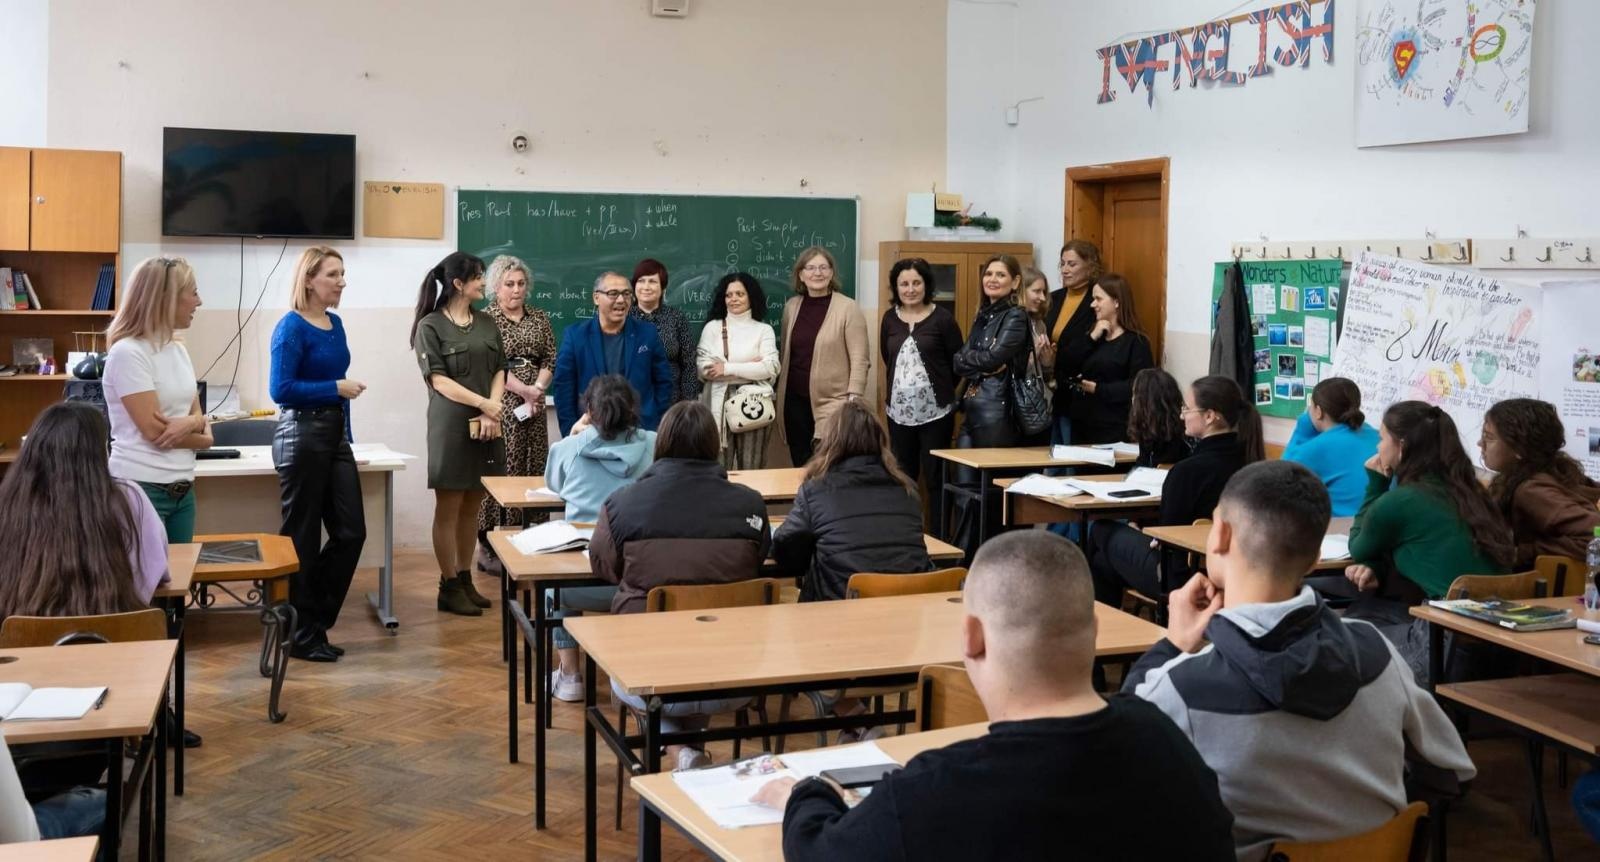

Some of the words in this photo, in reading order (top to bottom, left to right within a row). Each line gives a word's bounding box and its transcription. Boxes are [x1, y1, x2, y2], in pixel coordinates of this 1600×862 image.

[655, 199, 677, 213] when
[736, 217, 756, 233] Past
[761, 218, 799, 239] Simple
[1242, 262, 1286, 283] Wonders
[559, 287, 587, 300] about
[1386, 320, 1412, 362] 8
